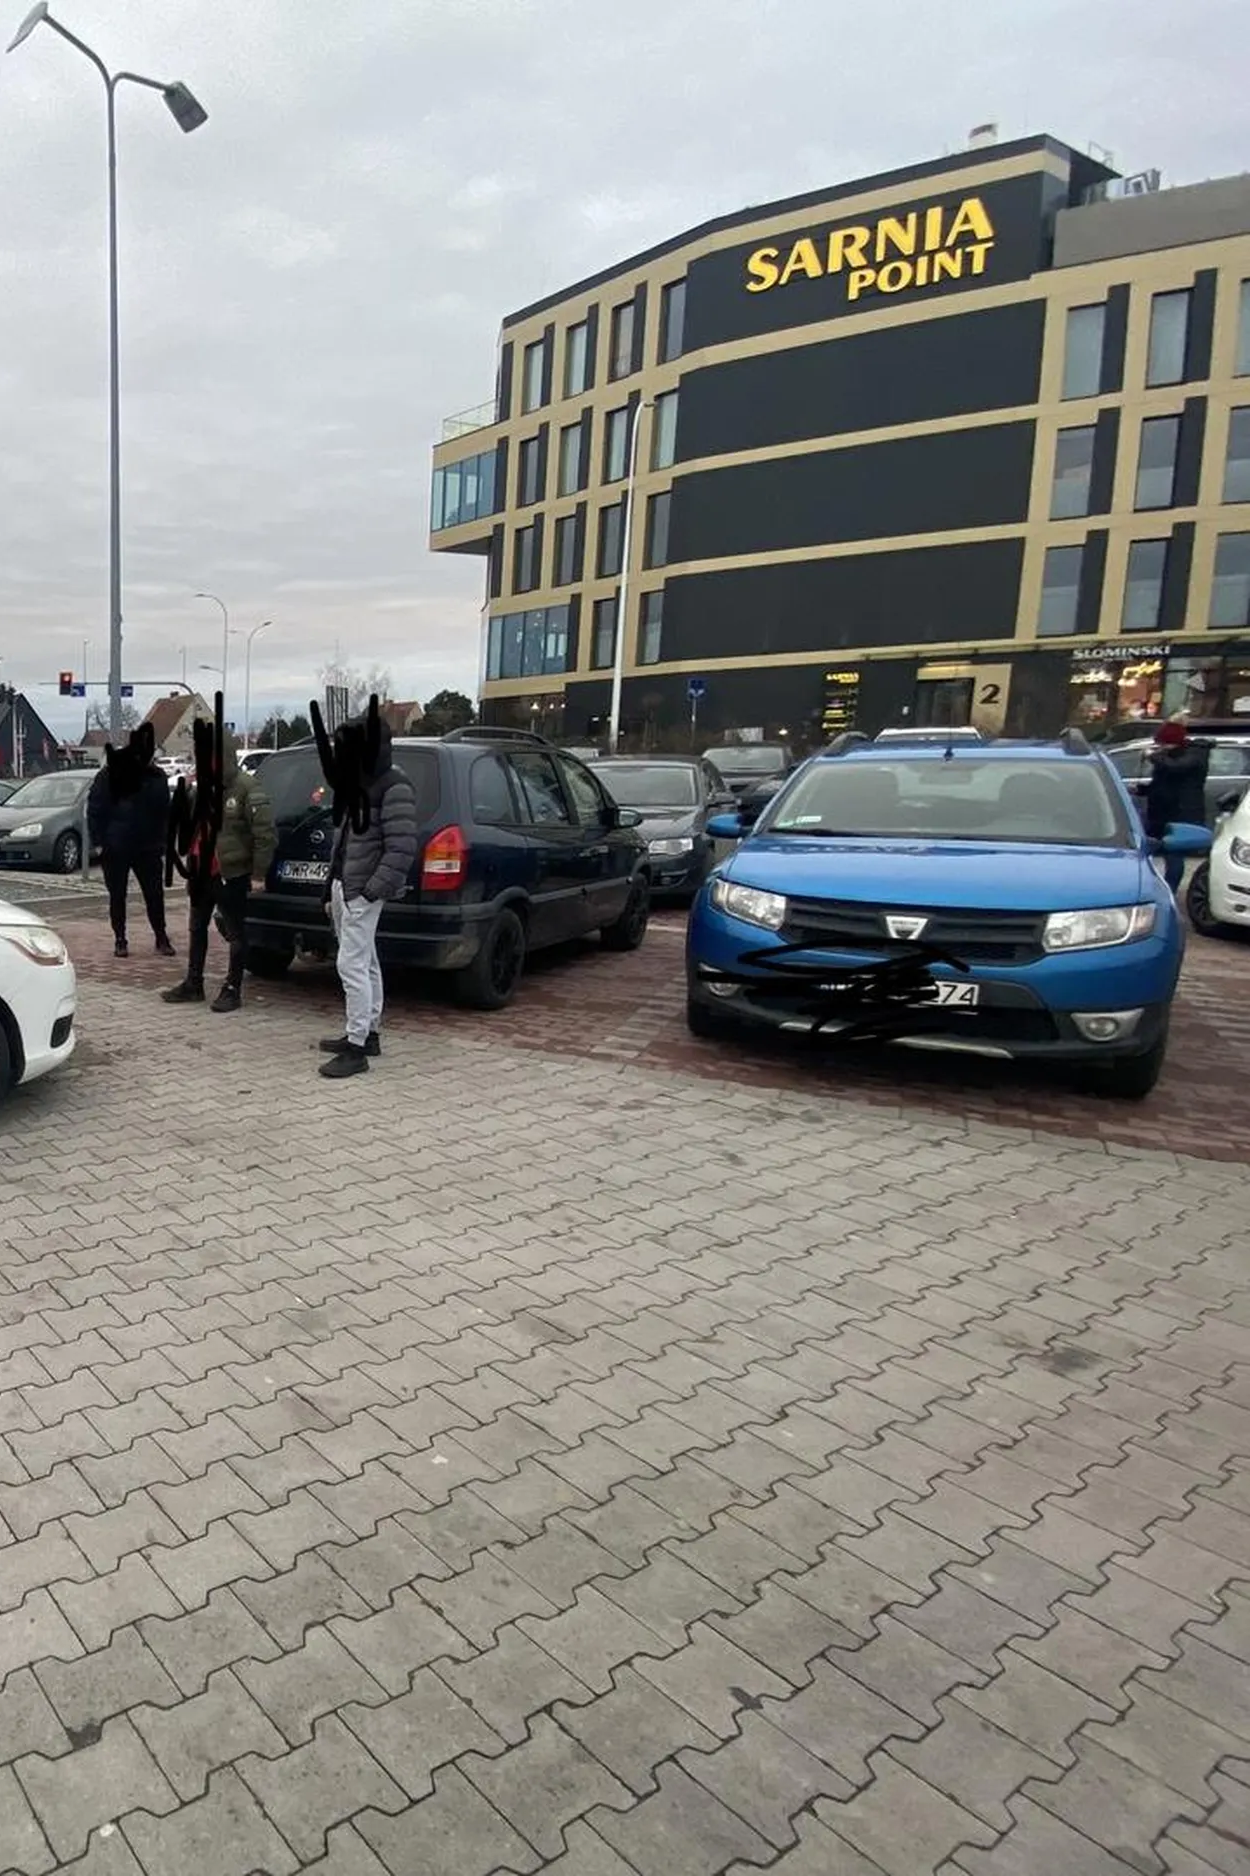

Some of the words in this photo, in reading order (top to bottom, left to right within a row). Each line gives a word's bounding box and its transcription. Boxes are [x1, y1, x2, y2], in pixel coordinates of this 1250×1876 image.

[746, 197, 994, 293] SARNIA
[848, 241, 995, 300] POINT
[979, 683, 1000, 704] 2
